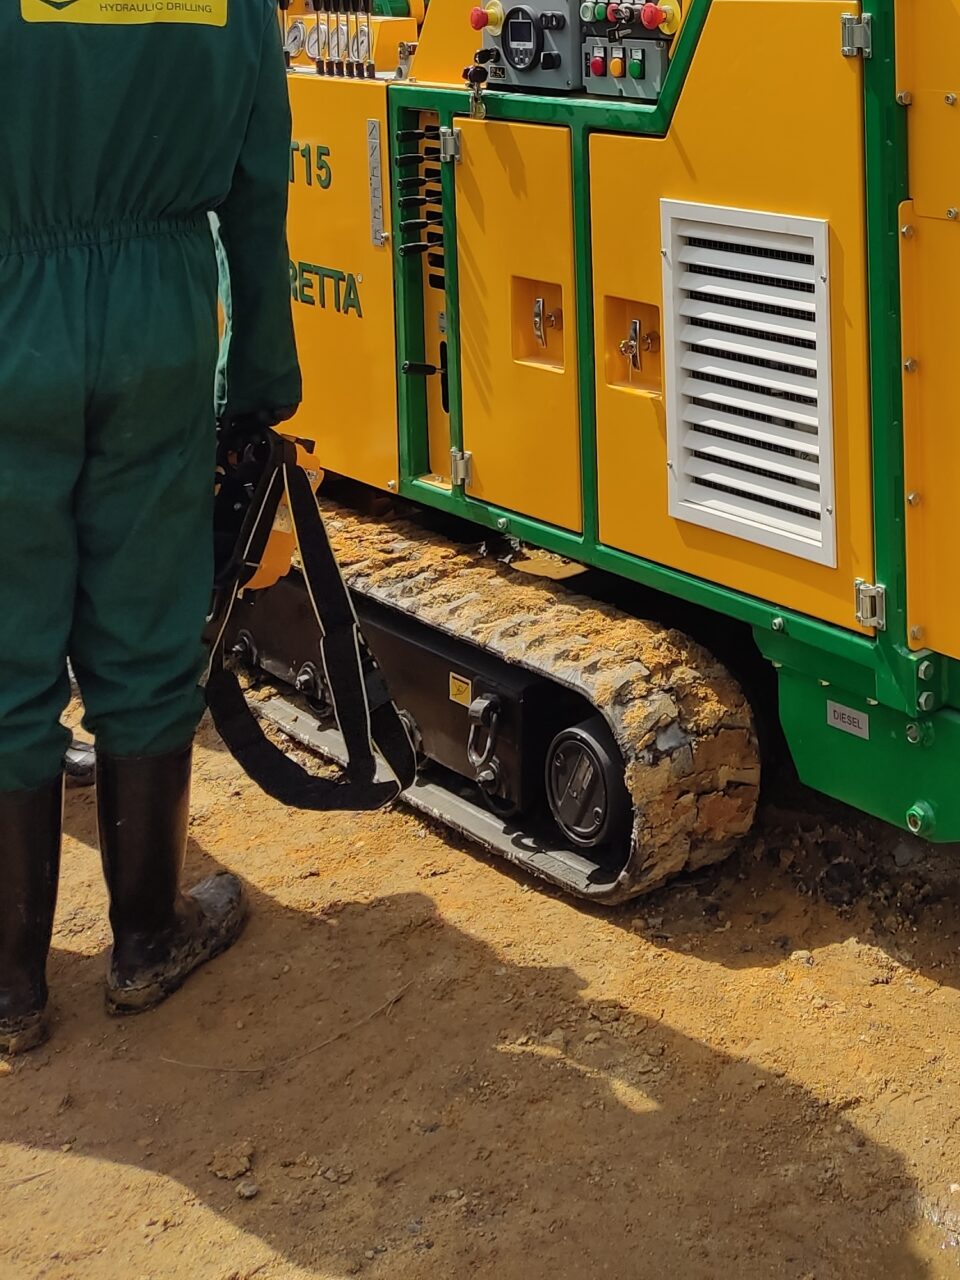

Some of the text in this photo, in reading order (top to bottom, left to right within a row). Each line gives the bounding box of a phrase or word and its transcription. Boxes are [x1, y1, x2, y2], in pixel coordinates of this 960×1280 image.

[100, 1, 212, 13] HYDRAULIC DRILLING
[833, 709, 864, 730] DIESEL
